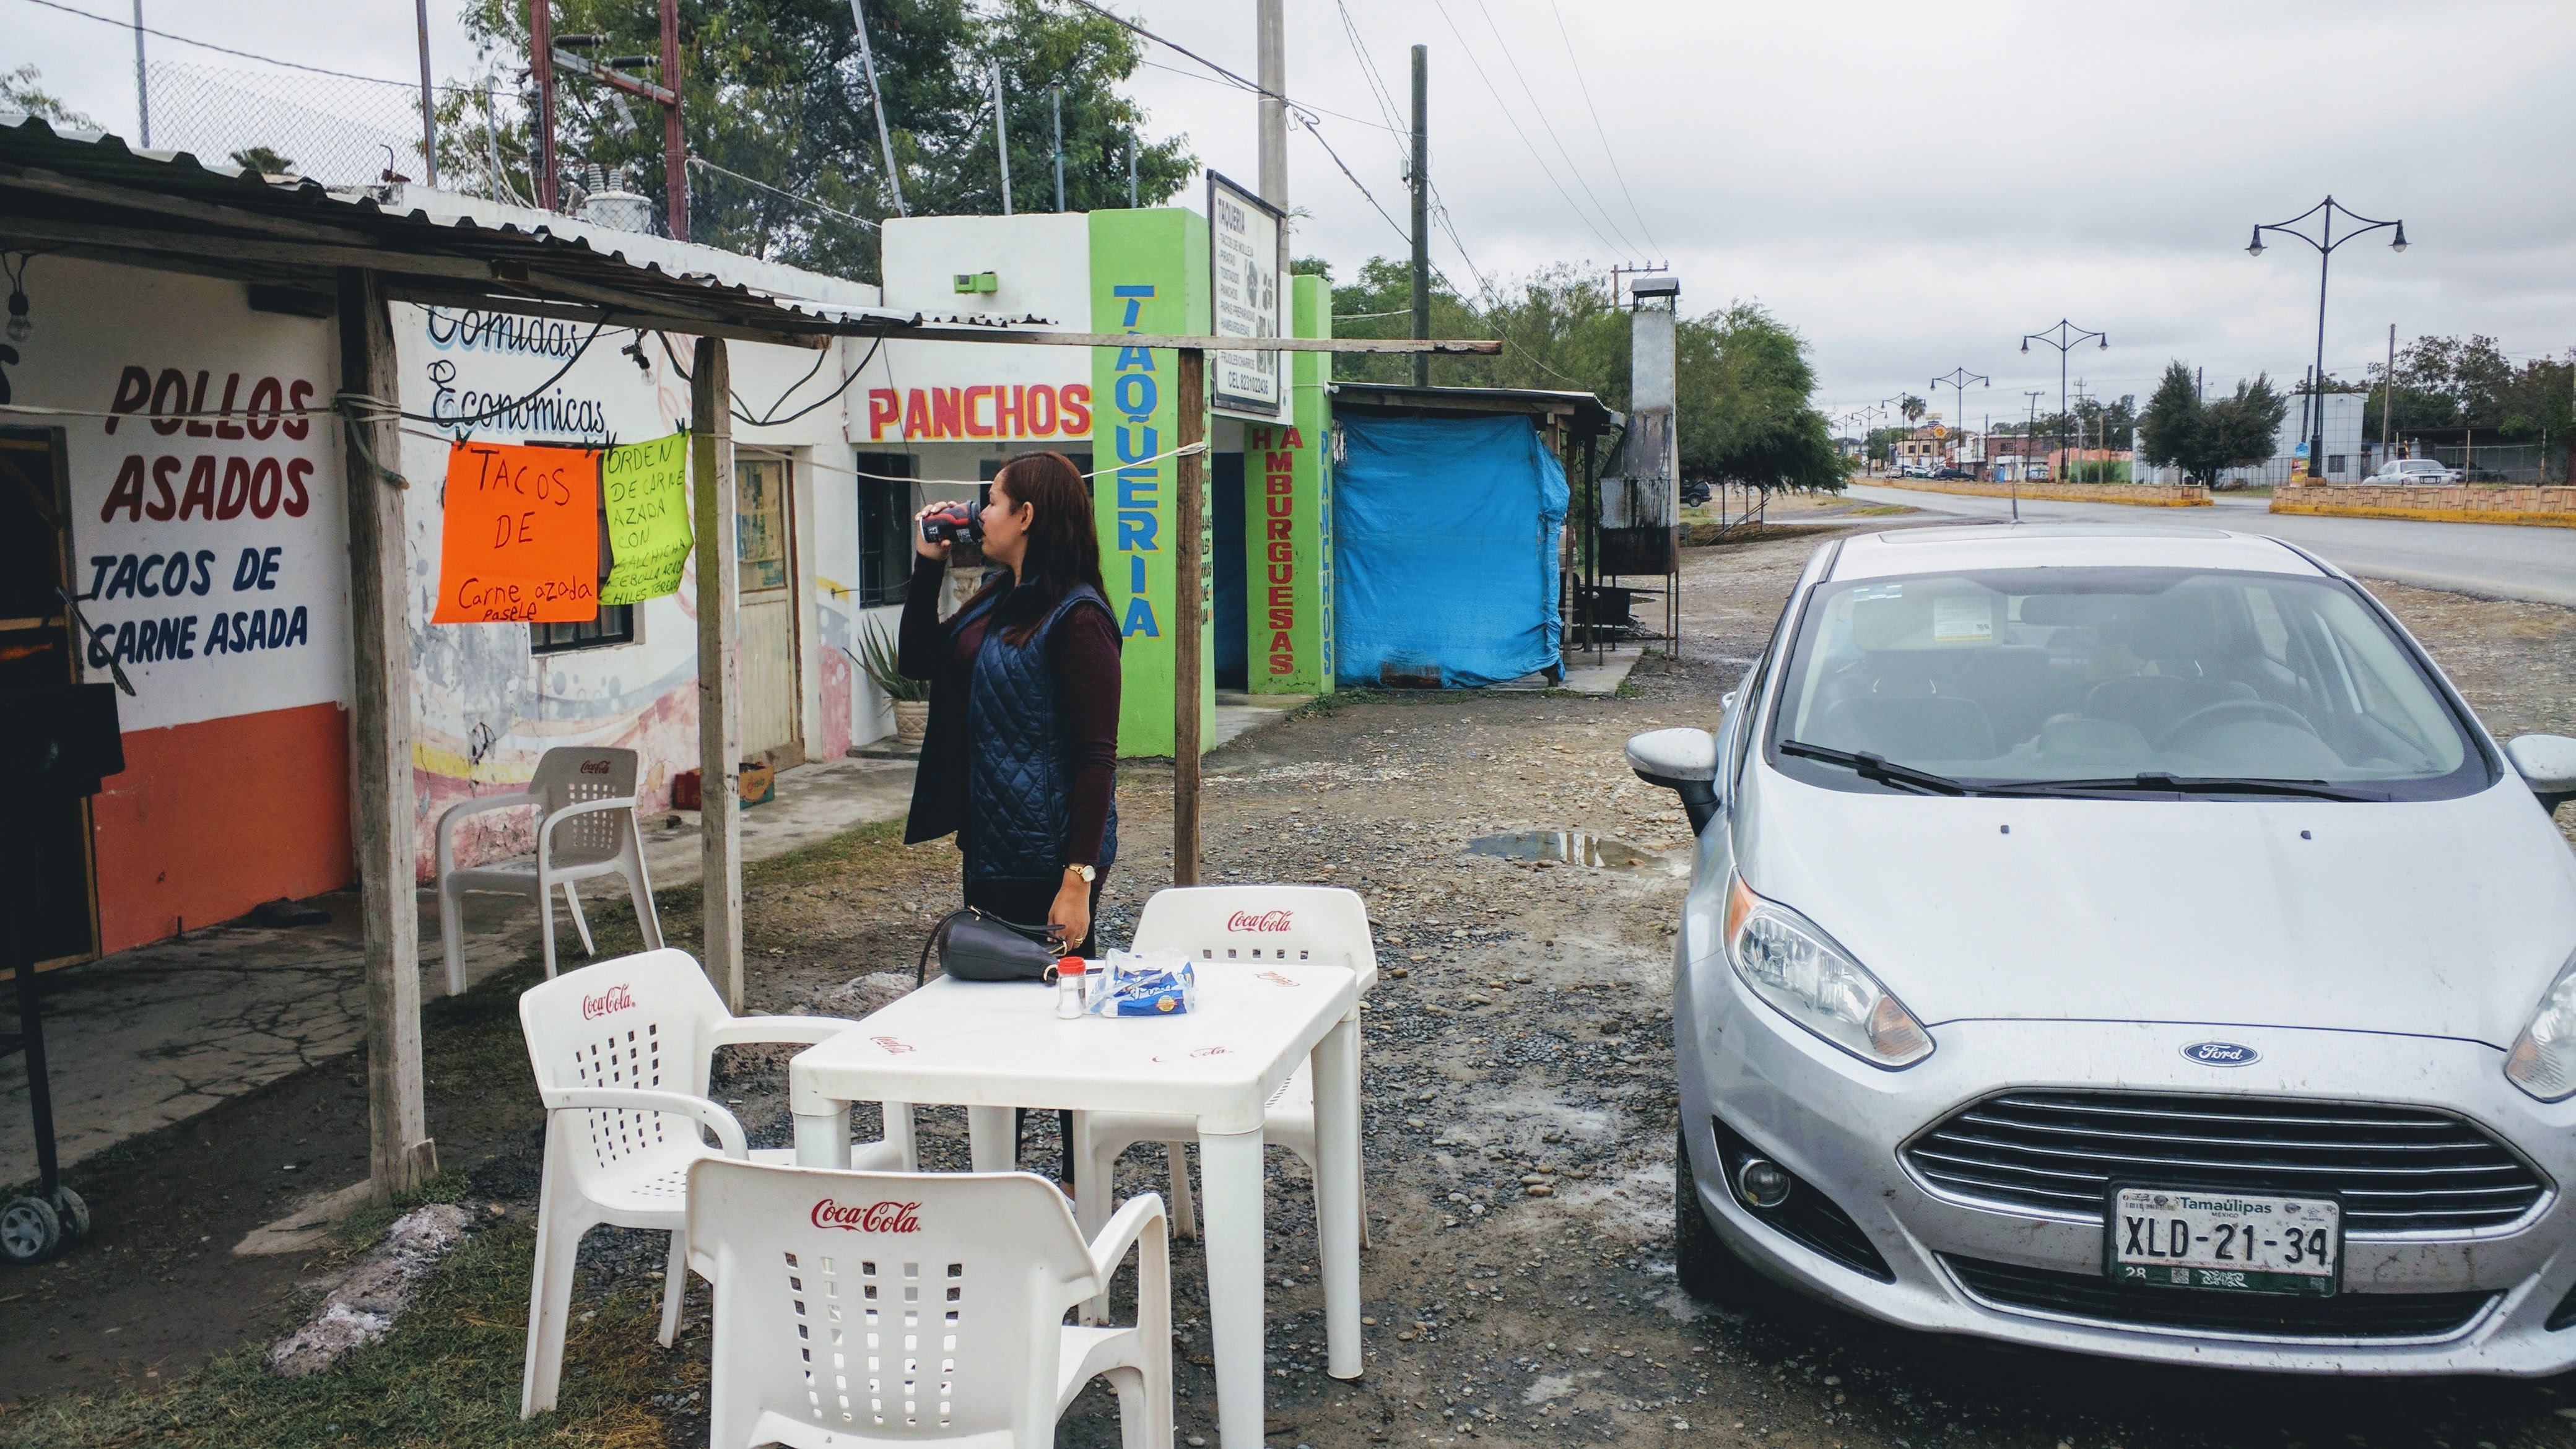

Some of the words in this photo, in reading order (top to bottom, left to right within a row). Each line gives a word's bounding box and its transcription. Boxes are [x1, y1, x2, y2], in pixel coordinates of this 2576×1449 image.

[1218, 198, 1245, 236] TAQUERIA
[1220, 232, 1232, 249] TACOS
[428, 308, 580, 357] Comidas
[1220, 317, 1250, 337] HAMBURGUESAS
[427, 360, 605, 433] Economicas
[1229, 372, 1239, 389] CEL
[105, 366, 313, 440] POLLOS
[869, 384, 1093, 441] PANCHOS
[608, 441, 672, 474] ORDEN
[1113, 285, 1160, 637] TAQUERIA
[101, 455, 313, 523] ASADOS
[471, 449, 570, 506] TACOS
[611, 480, 637, 503] DE
[643, 470, 684, 495] CARNE
[495, 511, 535, 549] DE
[614, 498, 666, 527] AZADA
[619, 527, 650, 549] CON
[1252, 427, 1303, 675] HAMBURGUESAS
[1321, 430, 1332, 675] PANCHOS
[613, 538, 685, 574] SALCHICHA
[90, 550, 215, 601] TACOS
[233, 547, 282, 591] DE
[606, 567, 660, 588] CEBOLLA
[663, 560, 684, 576] AZAD
[459, 578, 521, 609] Carne
[535, 575, 592, 602] azada
[599, 588, 647, 605] CHILES
[88, 616, 197, 668] CARNE
[204, 606, 307, 655] ASADA
[580, 760, 611, 774] Coca-Cola
[1228, 910, 1294, 933] Coca-Cola
[583, 984, 636, 1021] Coca-Cola
[2199, 1045, 2243, 1060] Ford
[811, 1199, 923, 1233] Coca-Cola
[2180, 1197, 2272, 1216] Tamaulipas
[2125, 1216, 2327, 1266] XLD-21-34
[2125, 1266, 2146, 1280] 28
